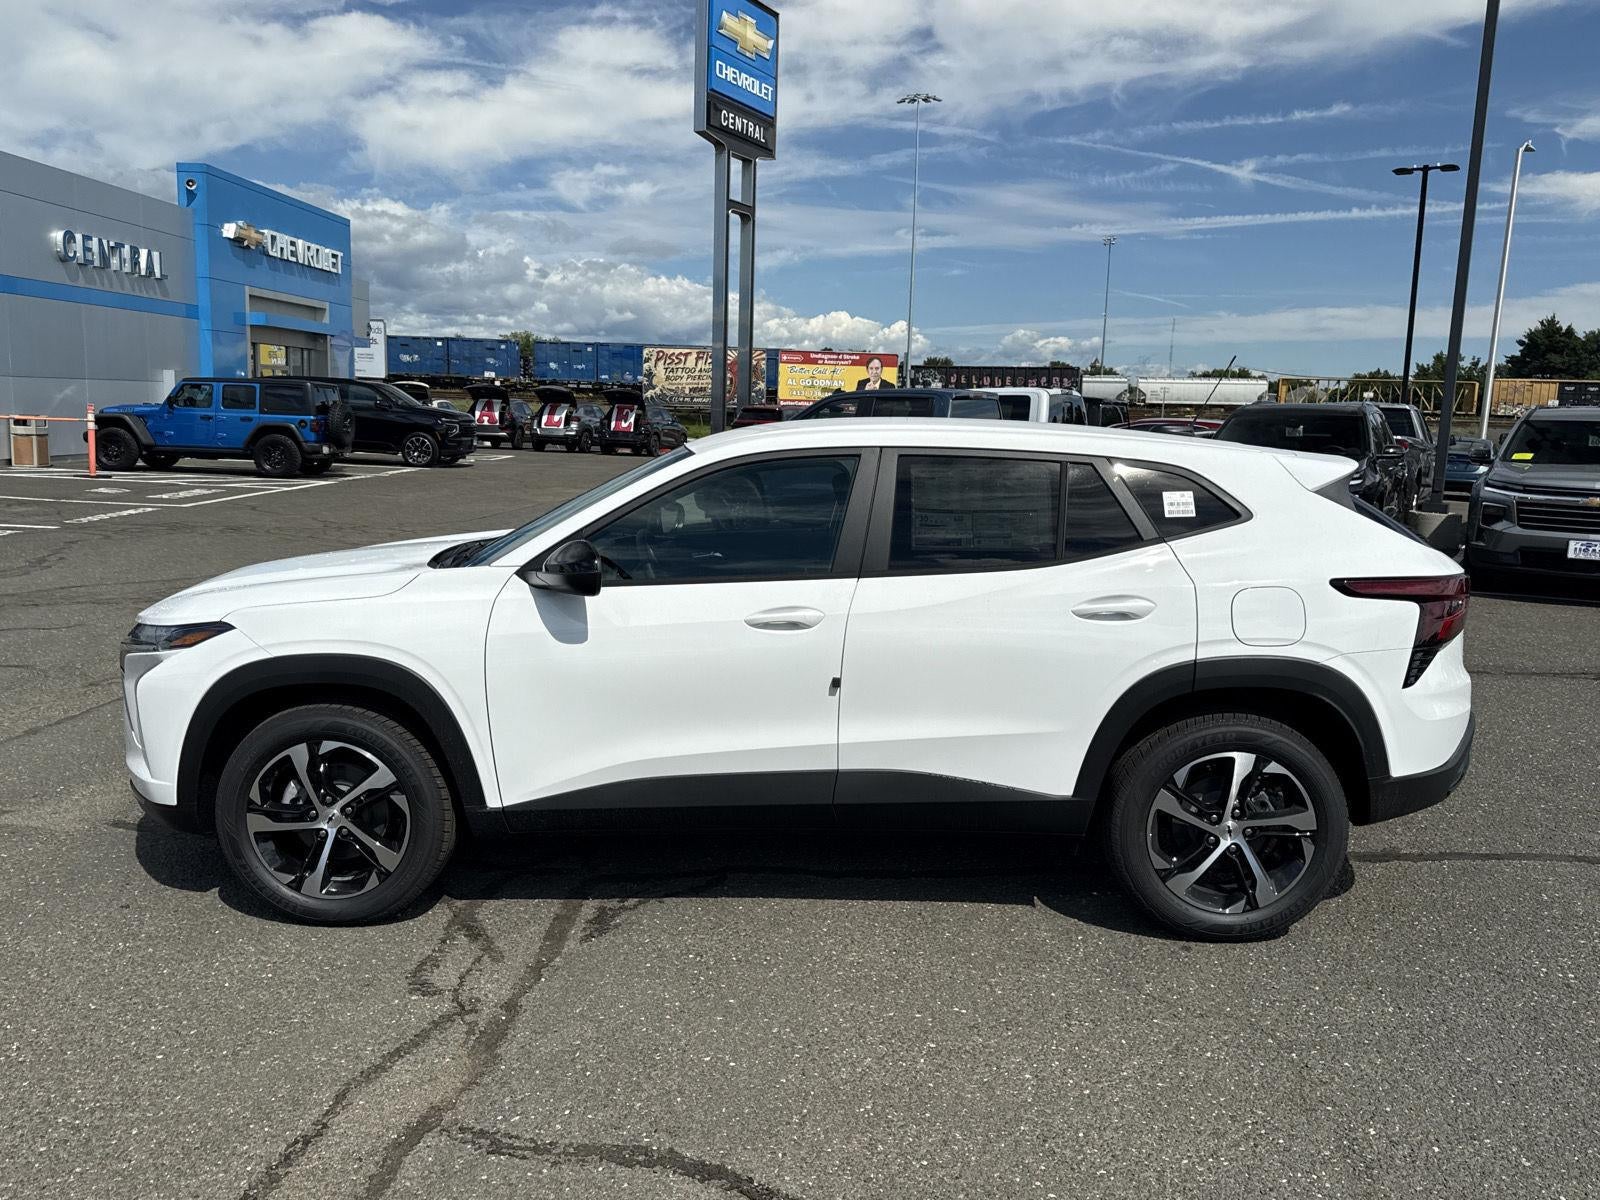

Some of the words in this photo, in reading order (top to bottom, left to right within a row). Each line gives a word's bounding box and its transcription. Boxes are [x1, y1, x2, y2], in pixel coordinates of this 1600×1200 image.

[716, 60, 773, 101] CHEVROLET
[721, 110, 765, 142] CENTRAL
[56, 229, 168, 280] CENTRAL
[264, 229, 343, 274] CHEVROLET
[654, 350, 693, 367] PISST
[664, 367, 696, 375] TATTOO
[812, 367, 828, 375] Call
[476, 399, 498, 425] A
[544, 403, 564, 428] L
[614, 405, 638, 432] E
